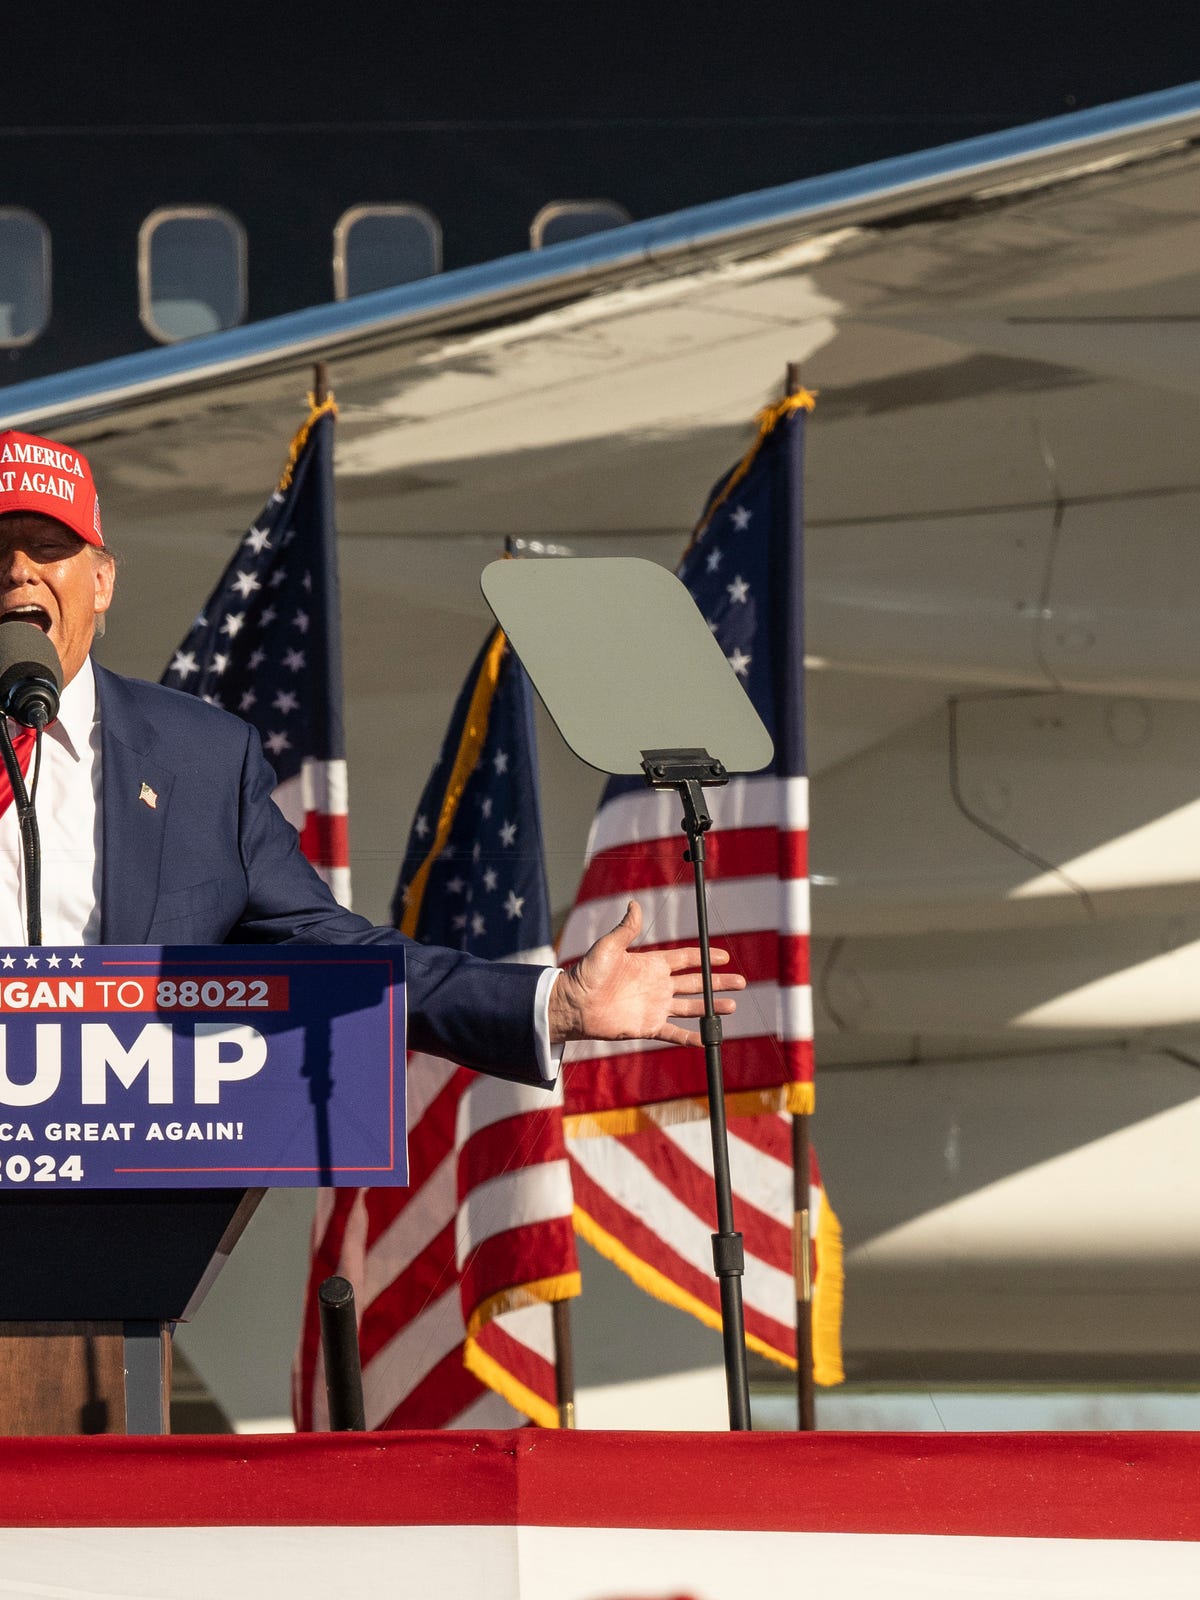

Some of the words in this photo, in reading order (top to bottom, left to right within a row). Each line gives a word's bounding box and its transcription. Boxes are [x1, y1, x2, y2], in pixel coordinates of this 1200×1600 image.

[0, 443, 85, 479] AMERICA
[19, 472, 76, 504] AGAIN
[96, 981, 144, 1008] TO
[156, 981, 269, 1007] 88022
[45, 1123, 136, 1141] GREAT
[146, 1122, 244, 1141] AGAIN!
